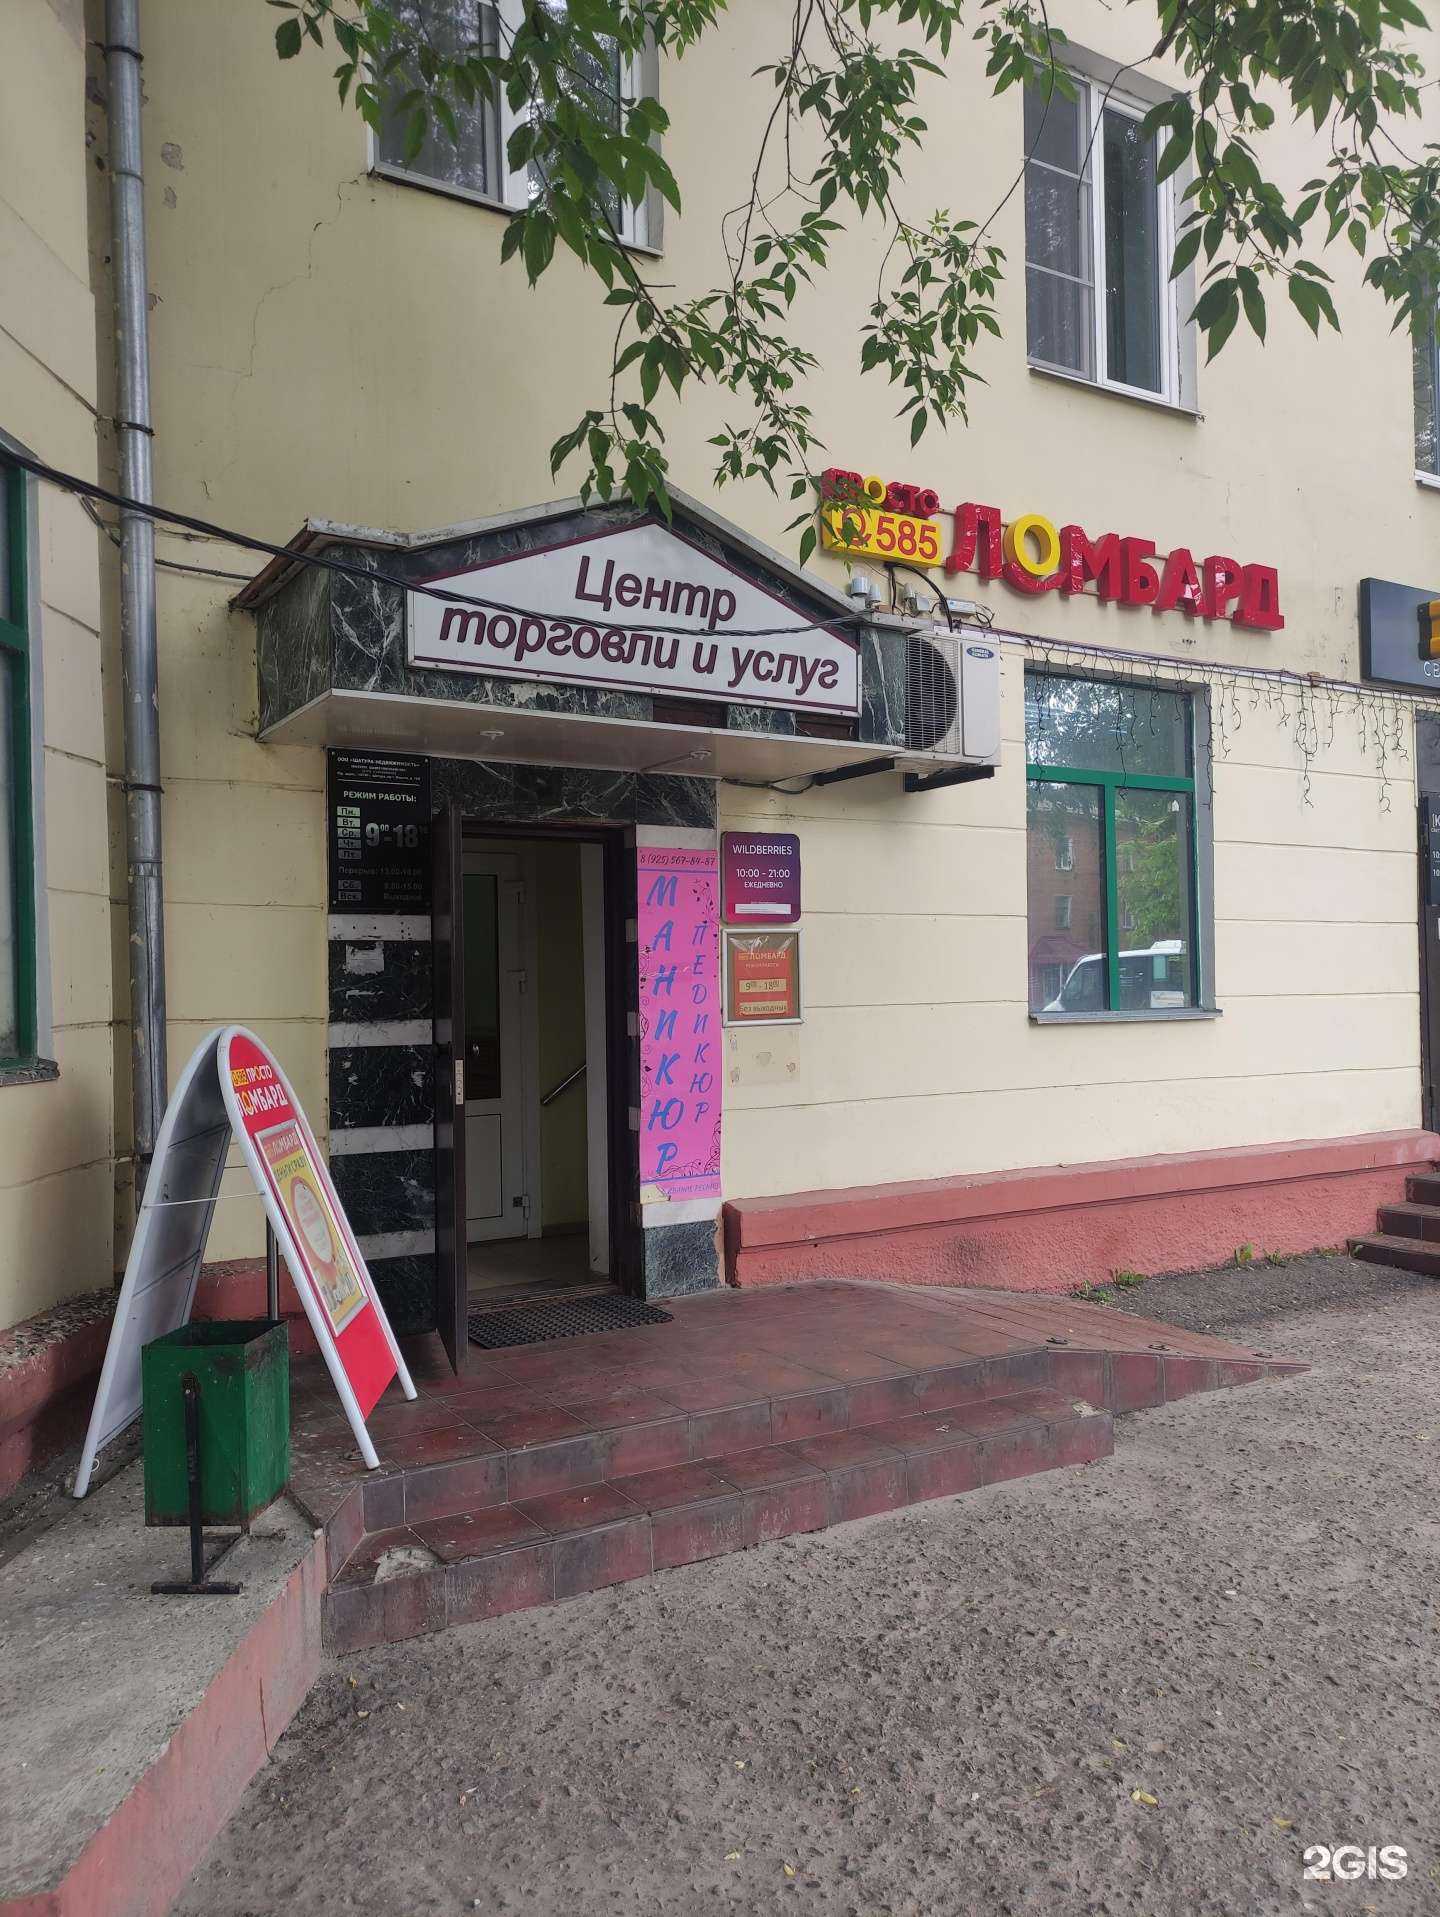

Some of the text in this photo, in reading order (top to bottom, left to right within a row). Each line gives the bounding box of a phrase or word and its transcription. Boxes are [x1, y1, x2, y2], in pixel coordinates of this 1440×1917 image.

[876, 515, 938, 560] 585
[946, 501, 1285, 632] ЛОМБАРД
[575, 555, 736, 630] Центр
[439, 606, 840, 696] торговли и услуг
[343, 790, 417, 803] РЕЖИМ РАБОТЫ:
[733, 844, 792, 855] WILDBERRIES
[736, 868, 760, 878] 10:00
[768, 869, 790, 878] 21:00
[646, 875, 685, 1175] МАНИКЮР
[246, 1065, 273, 1082] ПРОСТО
[234, 1083, 289, 1117] ЛОМБАРД
